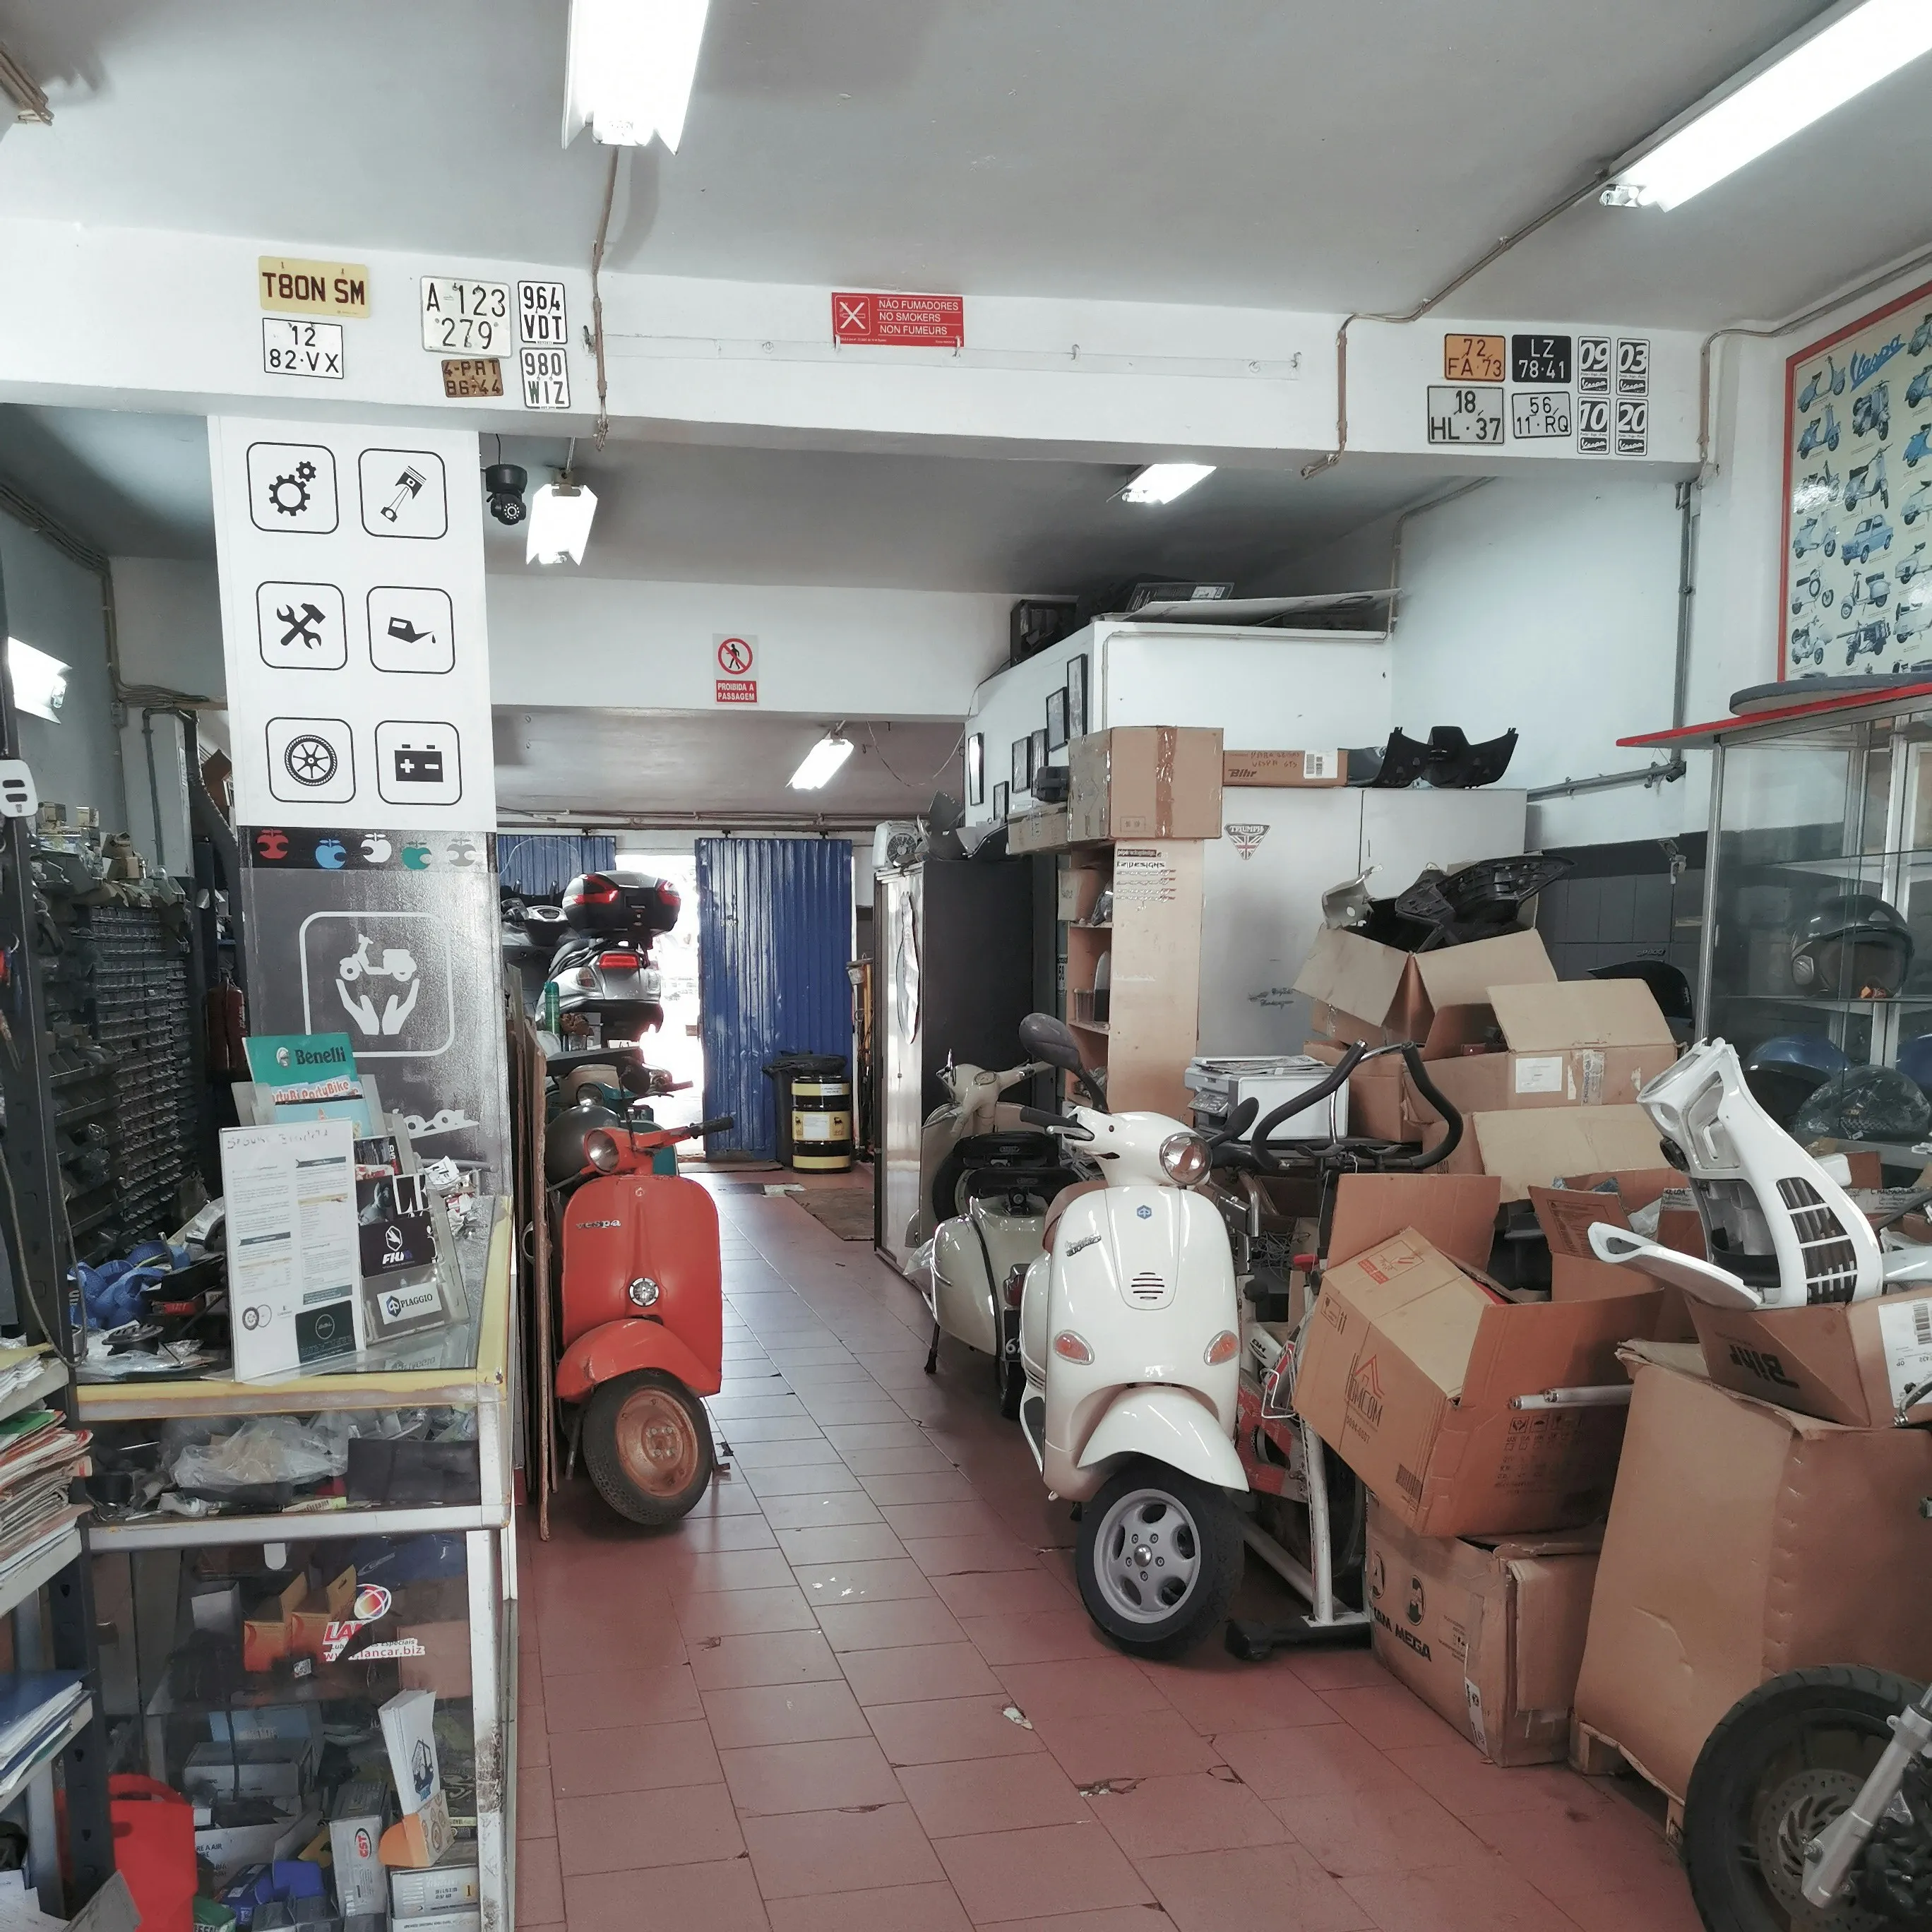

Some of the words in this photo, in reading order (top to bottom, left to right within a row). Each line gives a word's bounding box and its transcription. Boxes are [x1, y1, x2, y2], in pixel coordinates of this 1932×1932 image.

[334, 278, 365, 305] SM
[427, 282, 441, 312] A
[458, 285, 506, 317] 123
[523, 285, 561, 311] 964
[901, 300, 959, 311] FUMADORES
[524, 314, 562, 340] VDT
[879, 312, 893, 321] NO
[896, 313, 941, 323] SMOKERS
[291, 325, 316, 347] 12
[442, 317, 493, 350] 279
[880, 325, 900, 334] NON
[903, 326, 948, 335] FUMEURS
[1463, 338, 1487, 357] 72
[1530, 339, 1555, 358] LZ
[1580, 342, 1609, 370] 09
[1618, 344, 1647, 372] 03
[525, 352, 562, 376] 980
[1849, 333, 1907, 393] Vespa
[528, 381, 565, 405] WIZ
[1455, 390, 1477, 414] 18
[1530, 397, 1552, 415] 56
[1618, 404, 1645, 432] 20
[717, 682, 747, 691] PROIBIDA
[749, 683, 754, 691] A
[717, 692, 755, 700] PASSAGEM
[1229, 825, 1265, 833] TRIUMPH
[294, 1046, 347, 1065] Benelli
[302, 1080, 350, 1099] PartyBike
[576, 1220, 621, 1229] vespa
[400, 1293, 433, 1308] PIAGGIO
[1395, 1623, 1432, 1662] MEGA
[357, 1835, 369, 1858] CST
